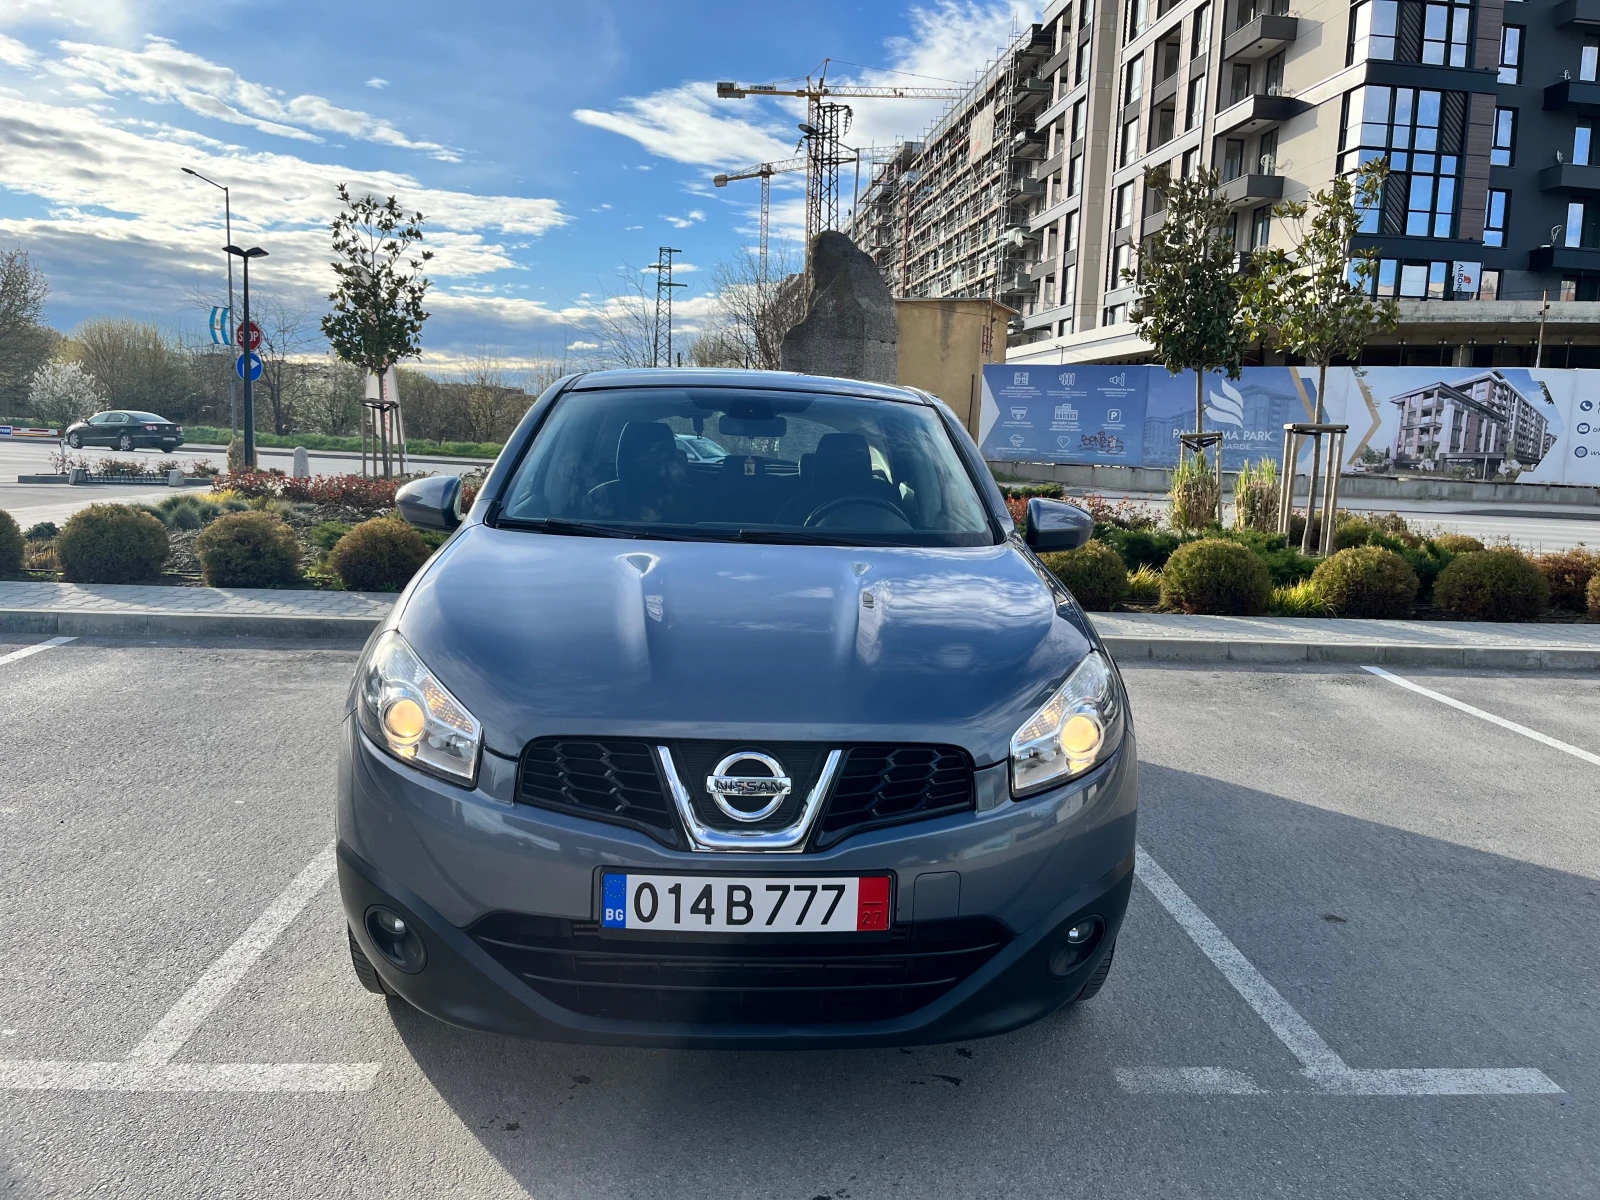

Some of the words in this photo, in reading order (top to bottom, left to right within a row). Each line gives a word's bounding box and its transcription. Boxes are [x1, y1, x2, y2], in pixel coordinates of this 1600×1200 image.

[238, 330, 259, 342] SOP
[1243, 430, 1272, 441] PARK
[715, 779, 782, 793] NISSAN
[605, 908, 624, 921] BG
[862, 911, 882, 925] 27
